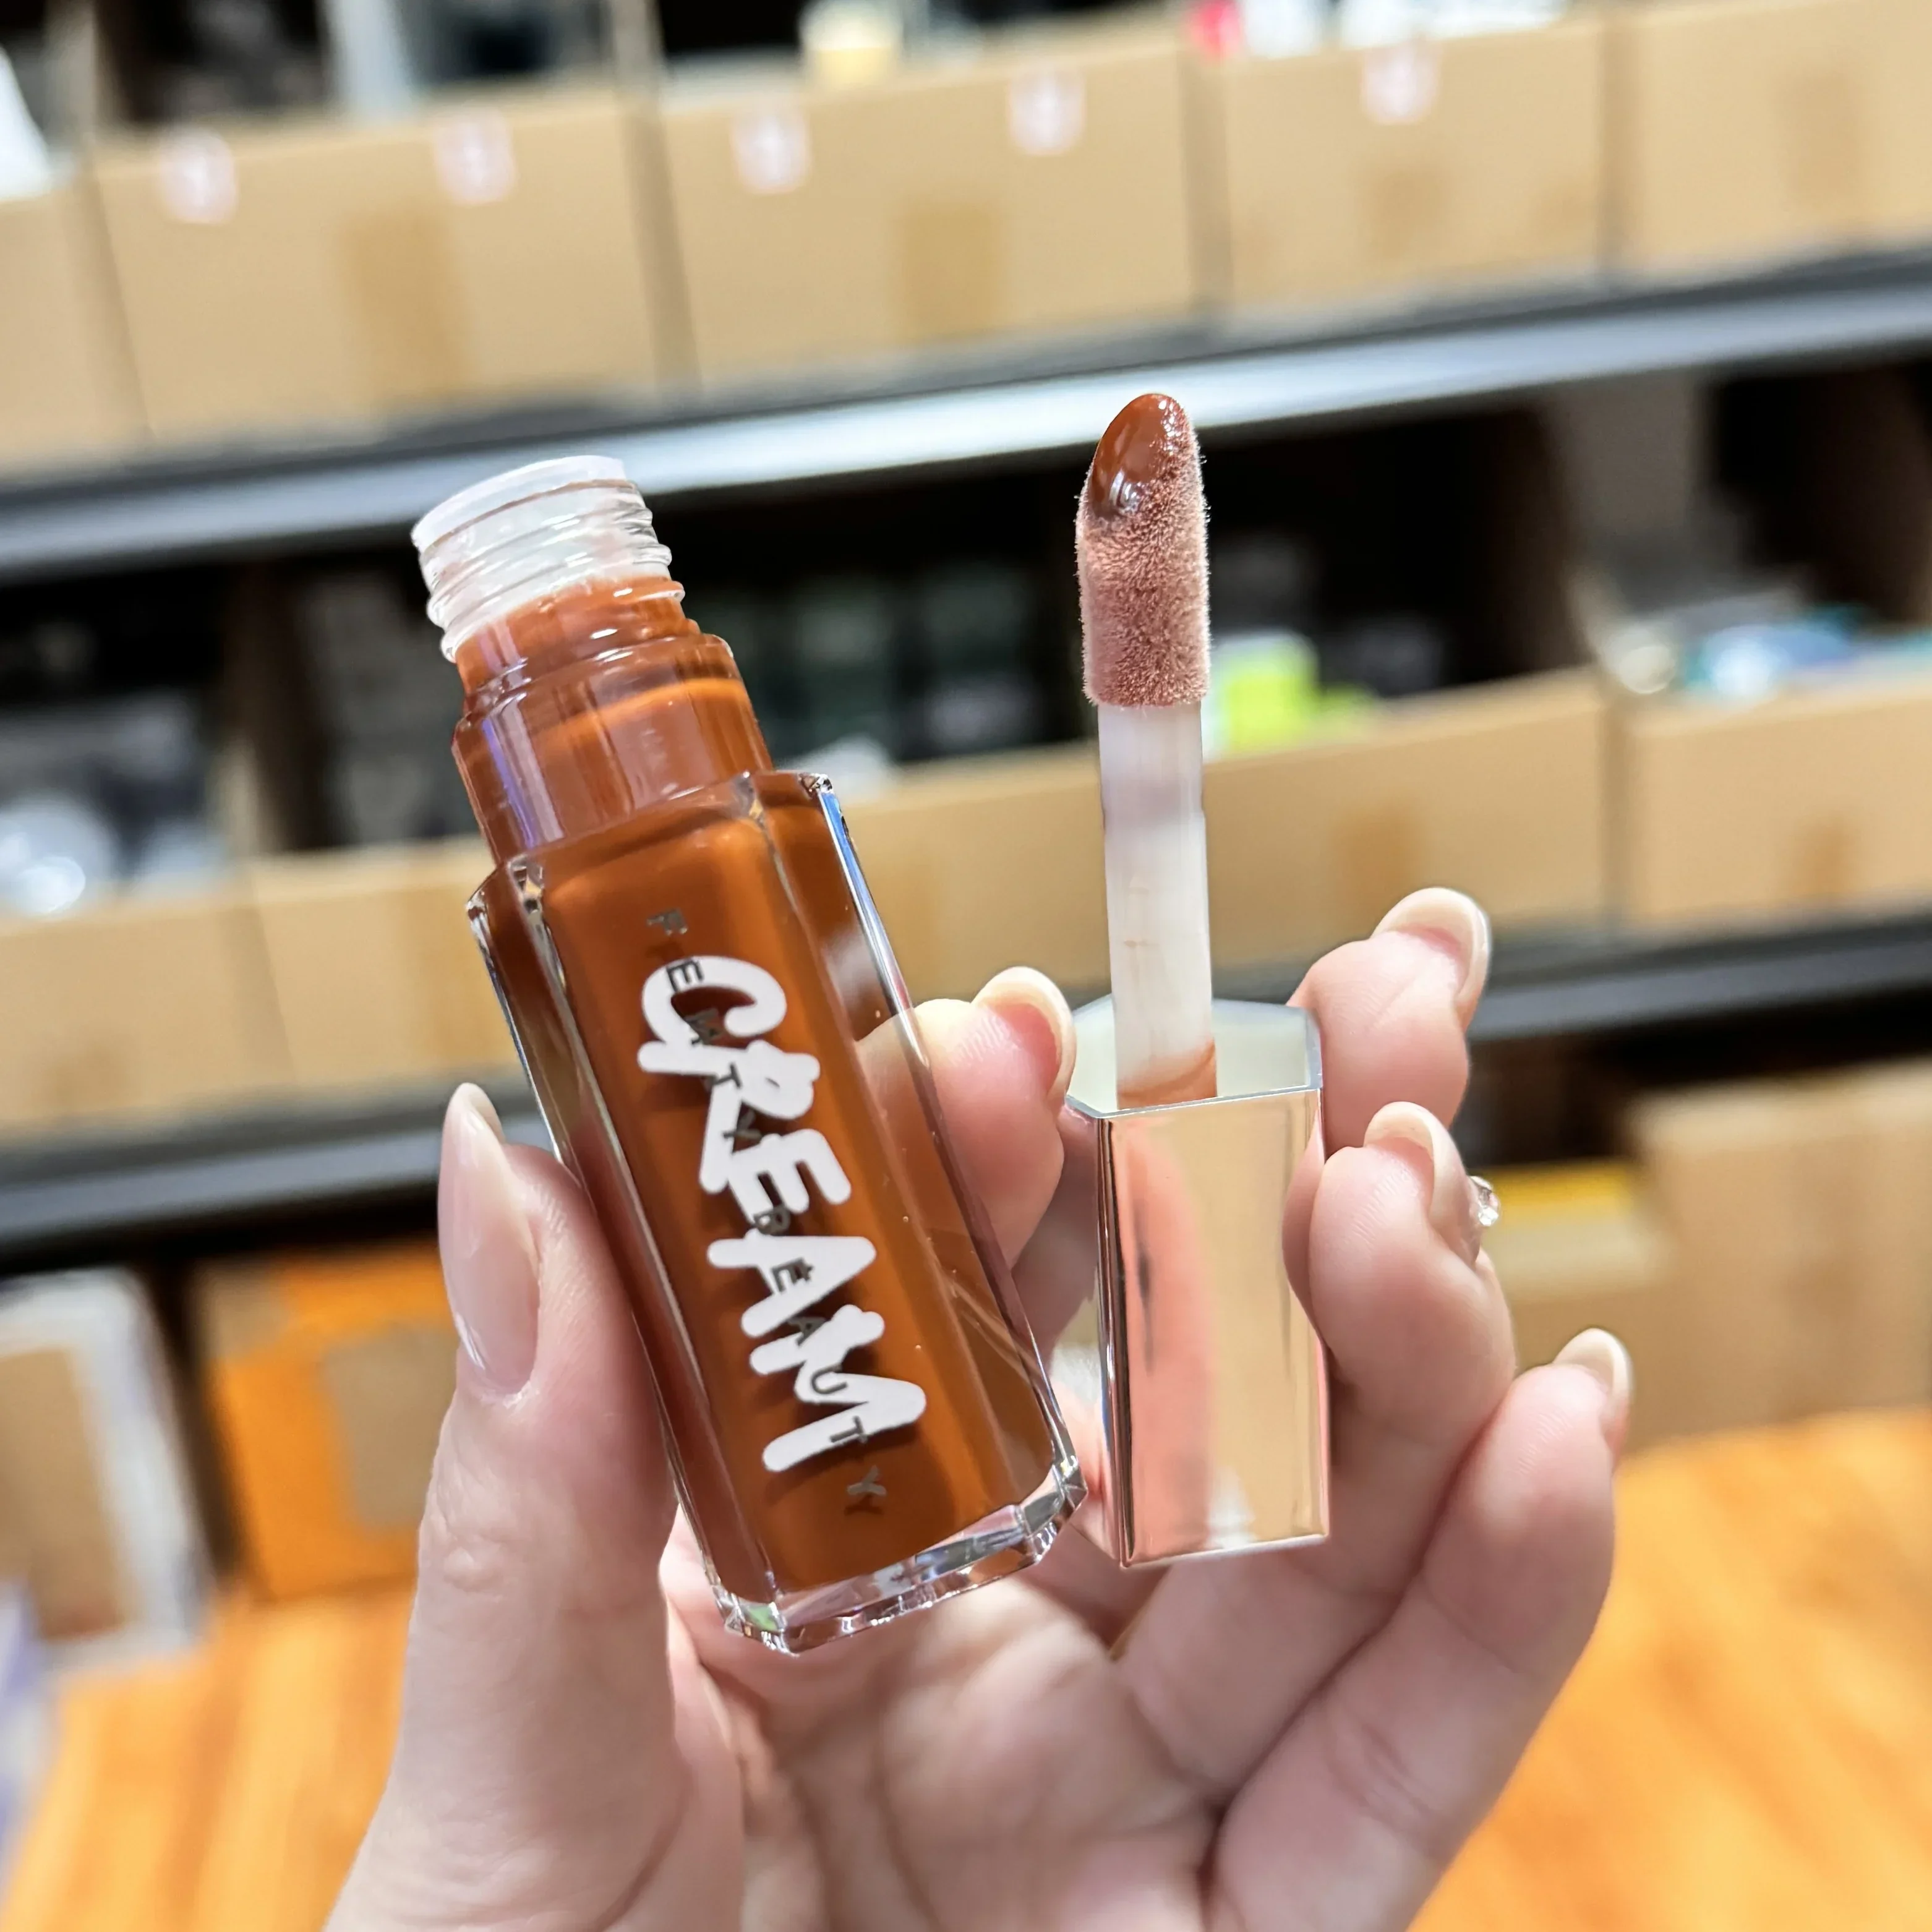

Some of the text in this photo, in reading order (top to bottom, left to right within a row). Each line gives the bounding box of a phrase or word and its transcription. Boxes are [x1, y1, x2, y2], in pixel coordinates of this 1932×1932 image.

[638, 955, 926, 1473] CREAM
[647, 907, 887, 1497] FENTY BEAUTY
